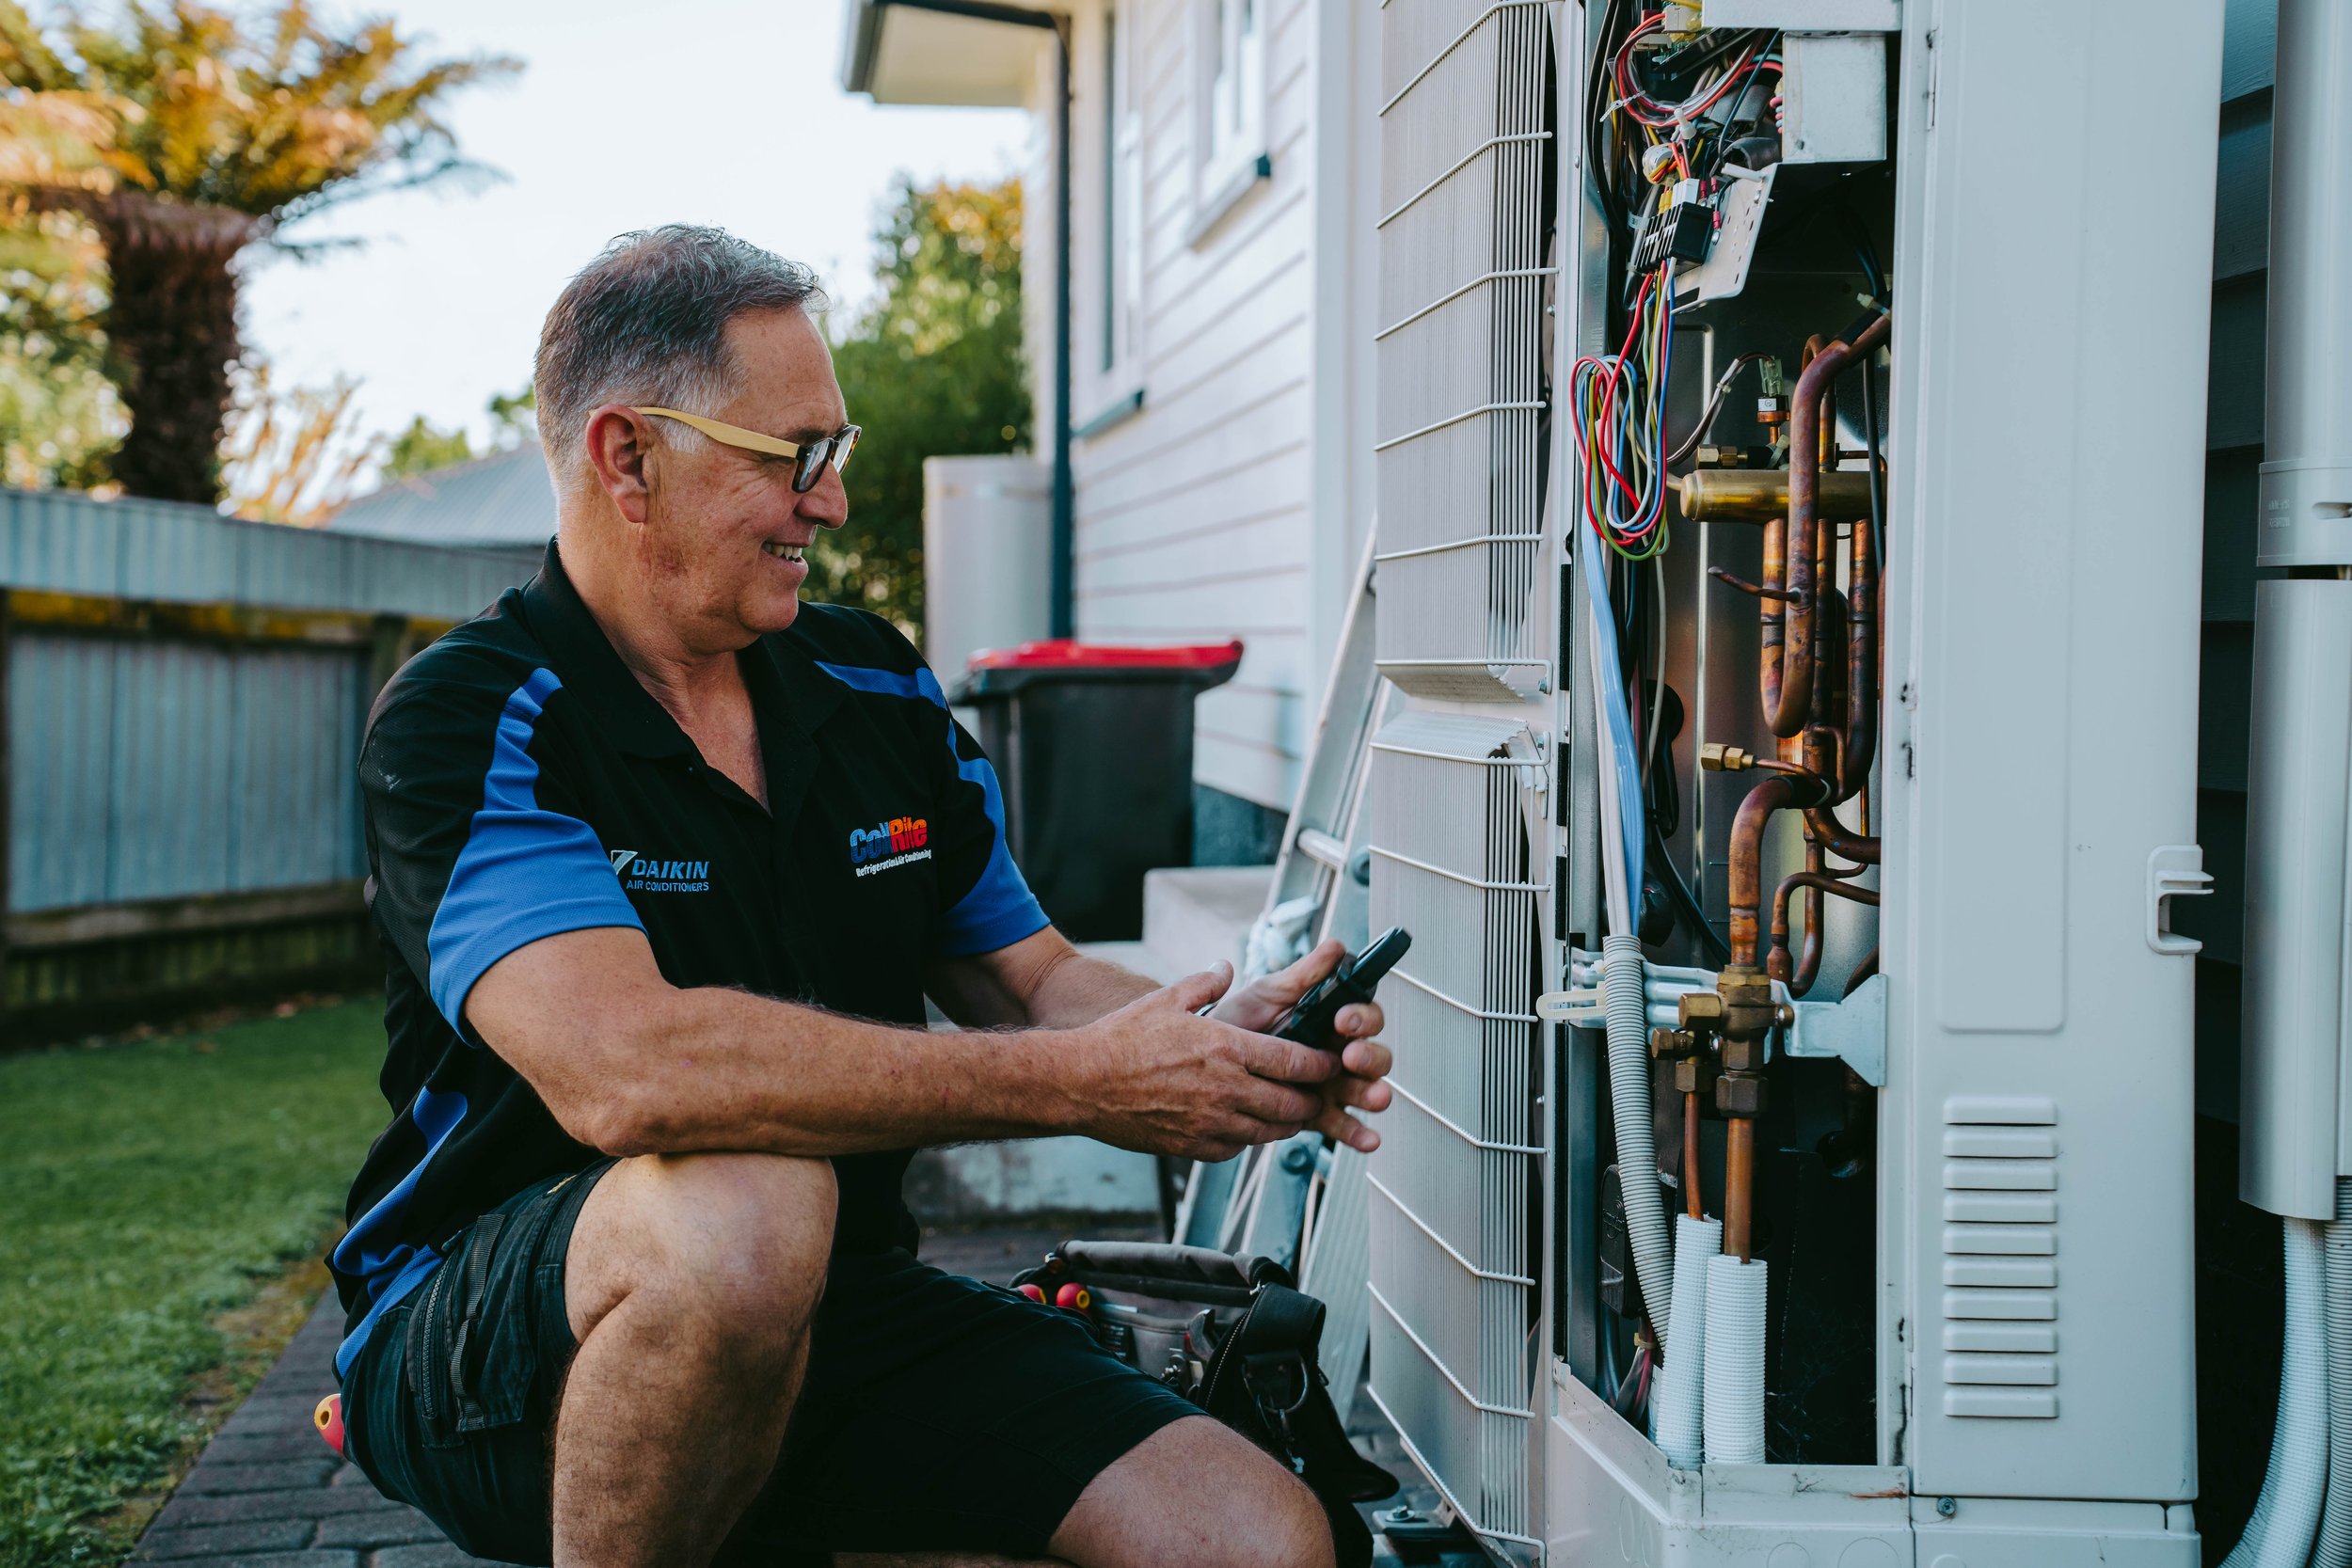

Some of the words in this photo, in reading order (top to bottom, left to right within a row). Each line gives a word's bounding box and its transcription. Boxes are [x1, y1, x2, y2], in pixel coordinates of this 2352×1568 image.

[631, 859, 709, 879] DAIKIN
[626, 879, 644, 890] AIR
[645, 881, 709, 892] CONDITIONERS
